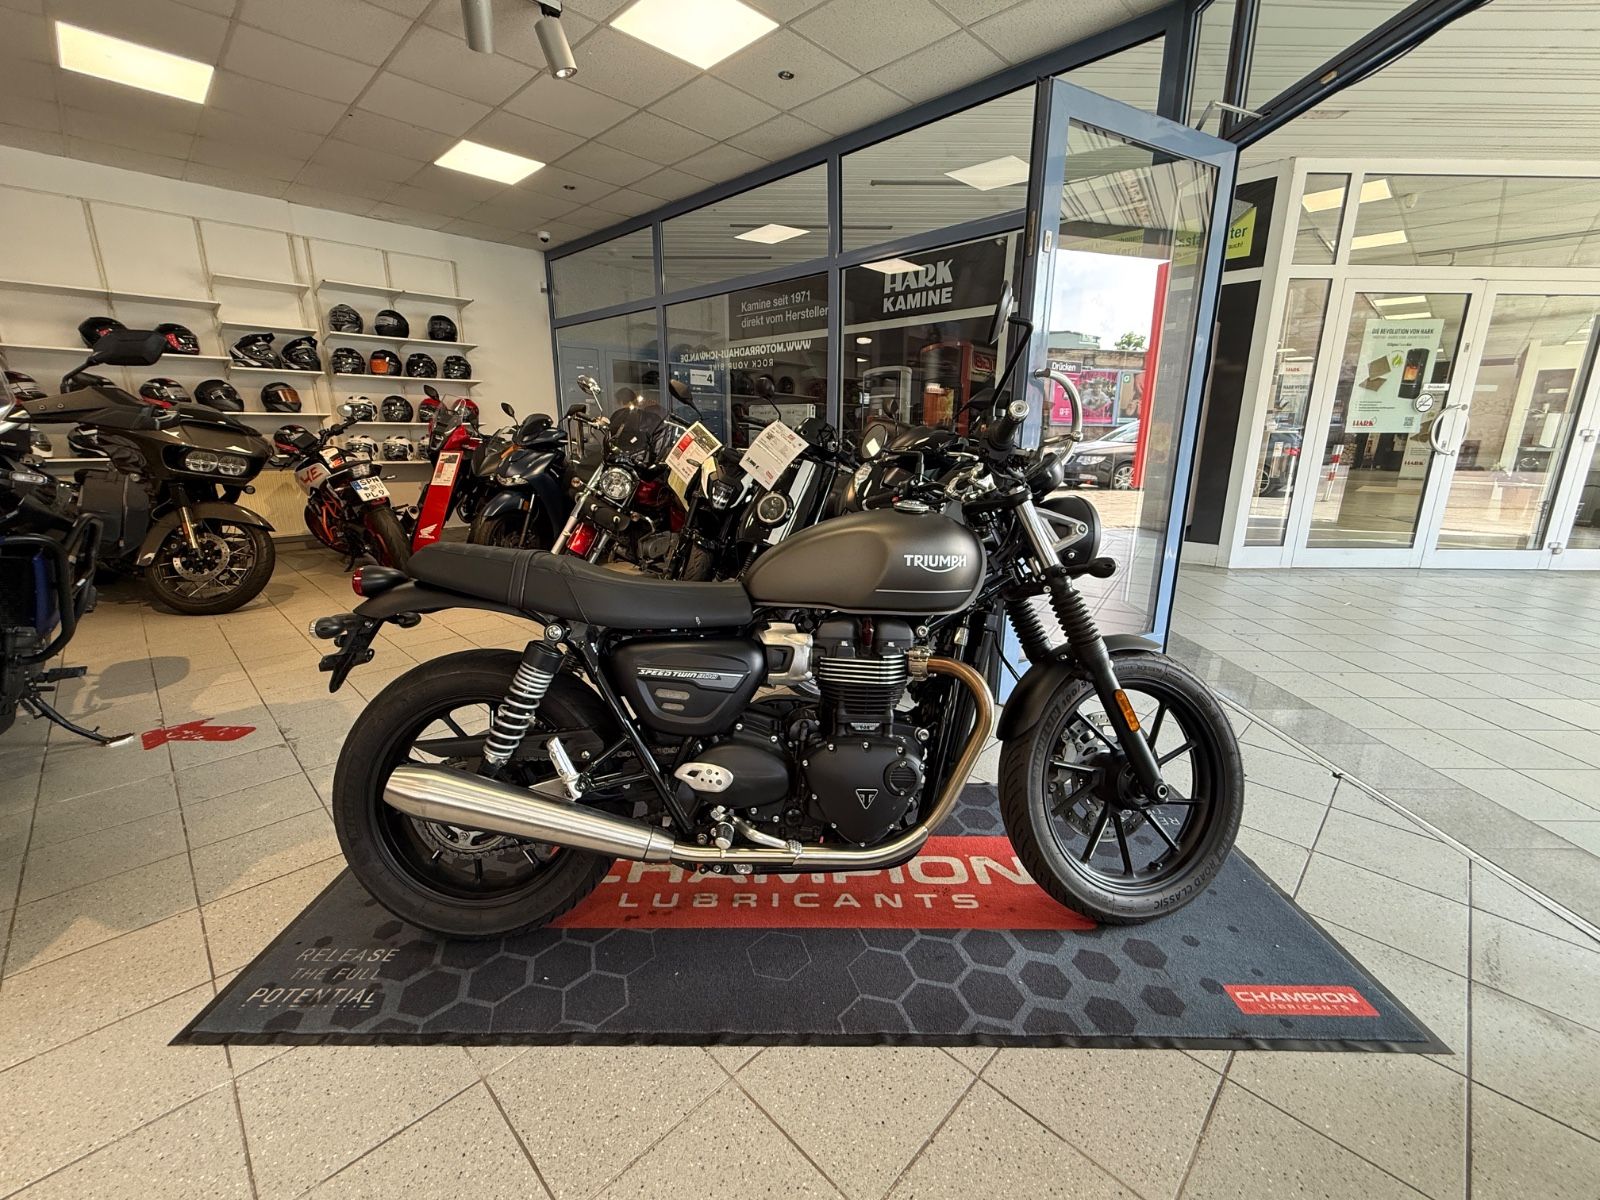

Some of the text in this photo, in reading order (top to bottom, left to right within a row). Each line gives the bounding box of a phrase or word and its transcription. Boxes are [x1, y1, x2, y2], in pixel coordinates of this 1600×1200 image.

[884, 259, 953, 294] HARK
[741, 290, 811, 312] Kamine seit 1971
[883, 287, 953, 313] KAMINE
[741, 305, 828, 328] direkt vom Hersteller
[1052, 362, 1076, 371] Drücken
[904, 554, 967, 572] TRIUMPH
[638, 669, 671, 677] SPEED
[601, 856, 1037, 884] HION
[1194, 859, 1216, 887] ROAD
[618, 893, 980, 908] LUBRICANTS
[1153, 885, 1193, 910] CLASSIC
[296, 949, 400, 962] RELEASE
[290, 967, 381, 981] THE FULL
[246, 988, 376, 1004] POTENTIAL
[1234, 991, 1359, 1004] CHAMPION
